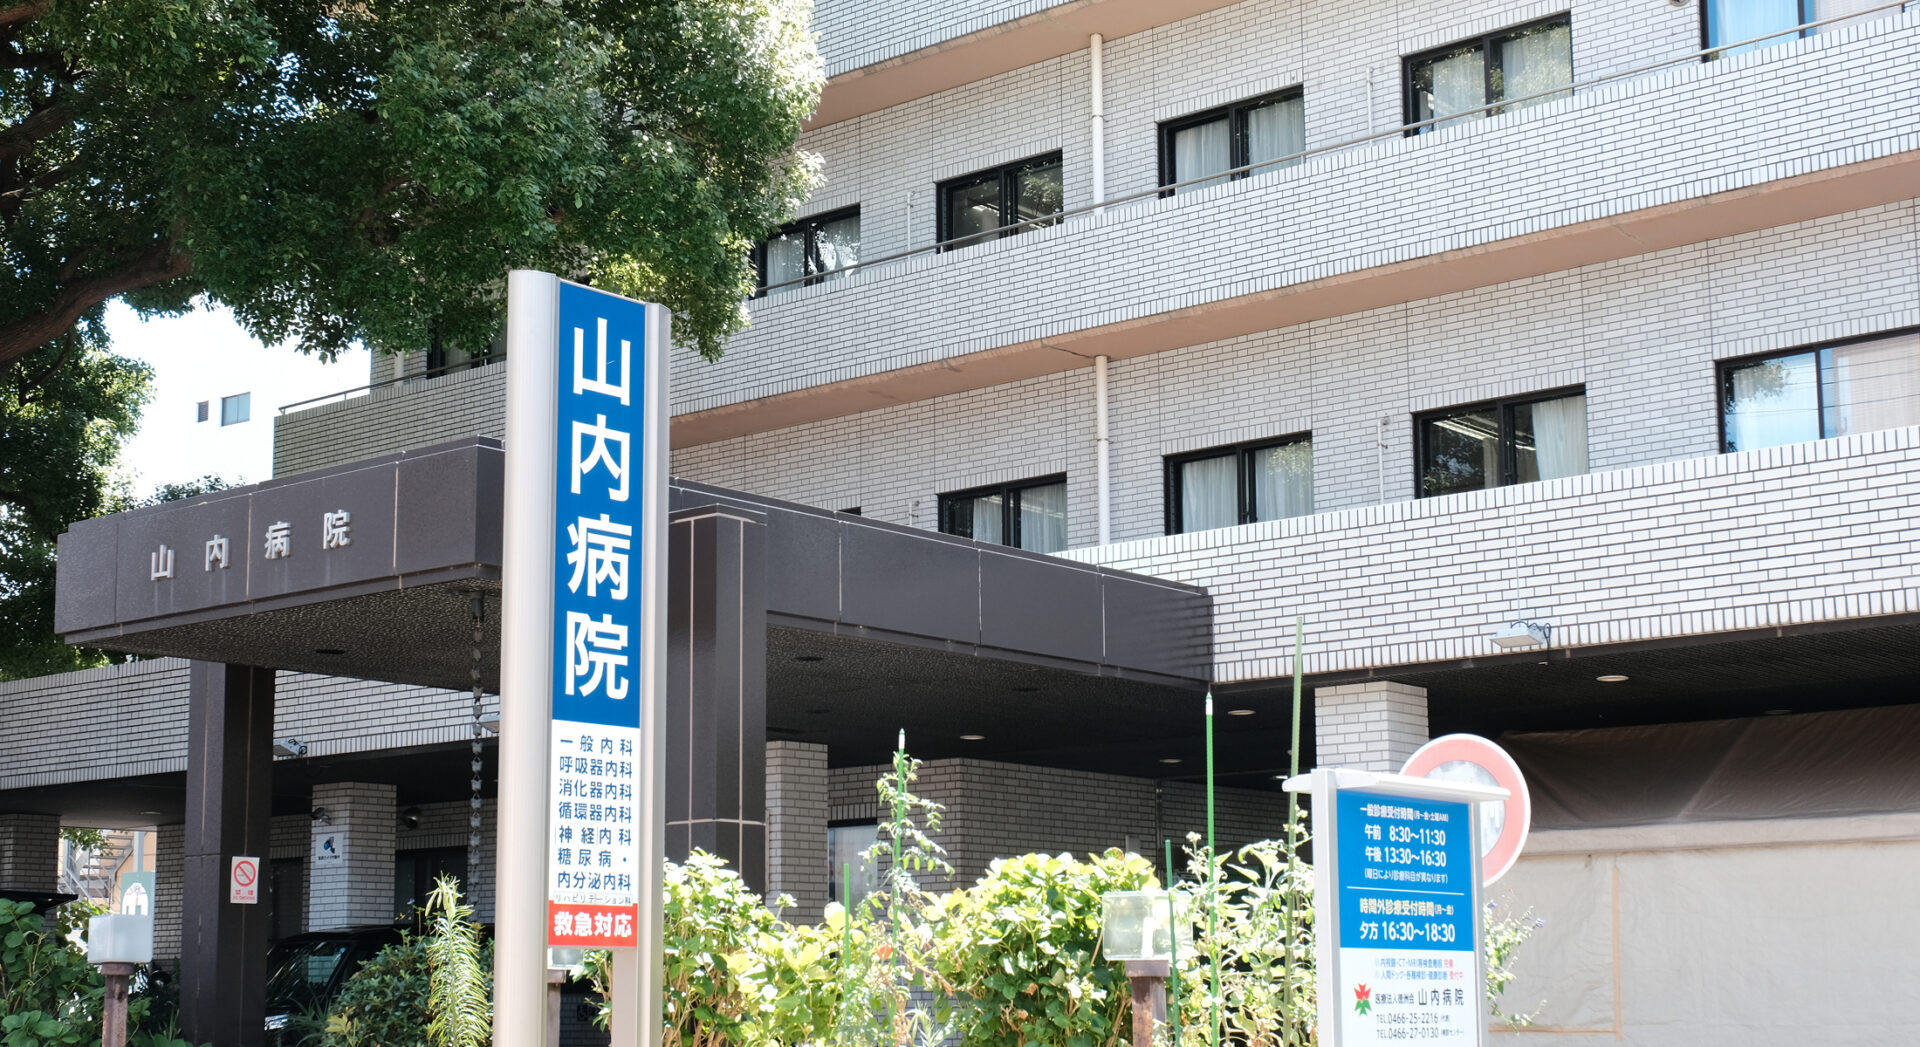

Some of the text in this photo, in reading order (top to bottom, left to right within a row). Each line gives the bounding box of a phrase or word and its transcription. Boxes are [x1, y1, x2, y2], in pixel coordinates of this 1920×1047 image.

[565, 317, 633, 700] 山内病院
[151, 509, 351, 581] 山内病院
[560, 735, 633, 756] 一般内科
[559, 756, 632, 779] 呼吸器内科
[559, 778, 632, 801] 消化器内科
[558, 802, 632, 824] 循環器内科
[558, 825, 632, 846] 神経内科
[1365, 824, 1382, 840] 午前
[1365, 846, 1382, 863] 午後
[557, 871, 631, 891] 内分泌内科
[555, 894, 632, 905] リハビリテーション科
[554, 911, 633, 938] 救急対応
[1360, 921, 1379, 940] 夕方
[1418, 988, 1464, 1006] 山内病院
